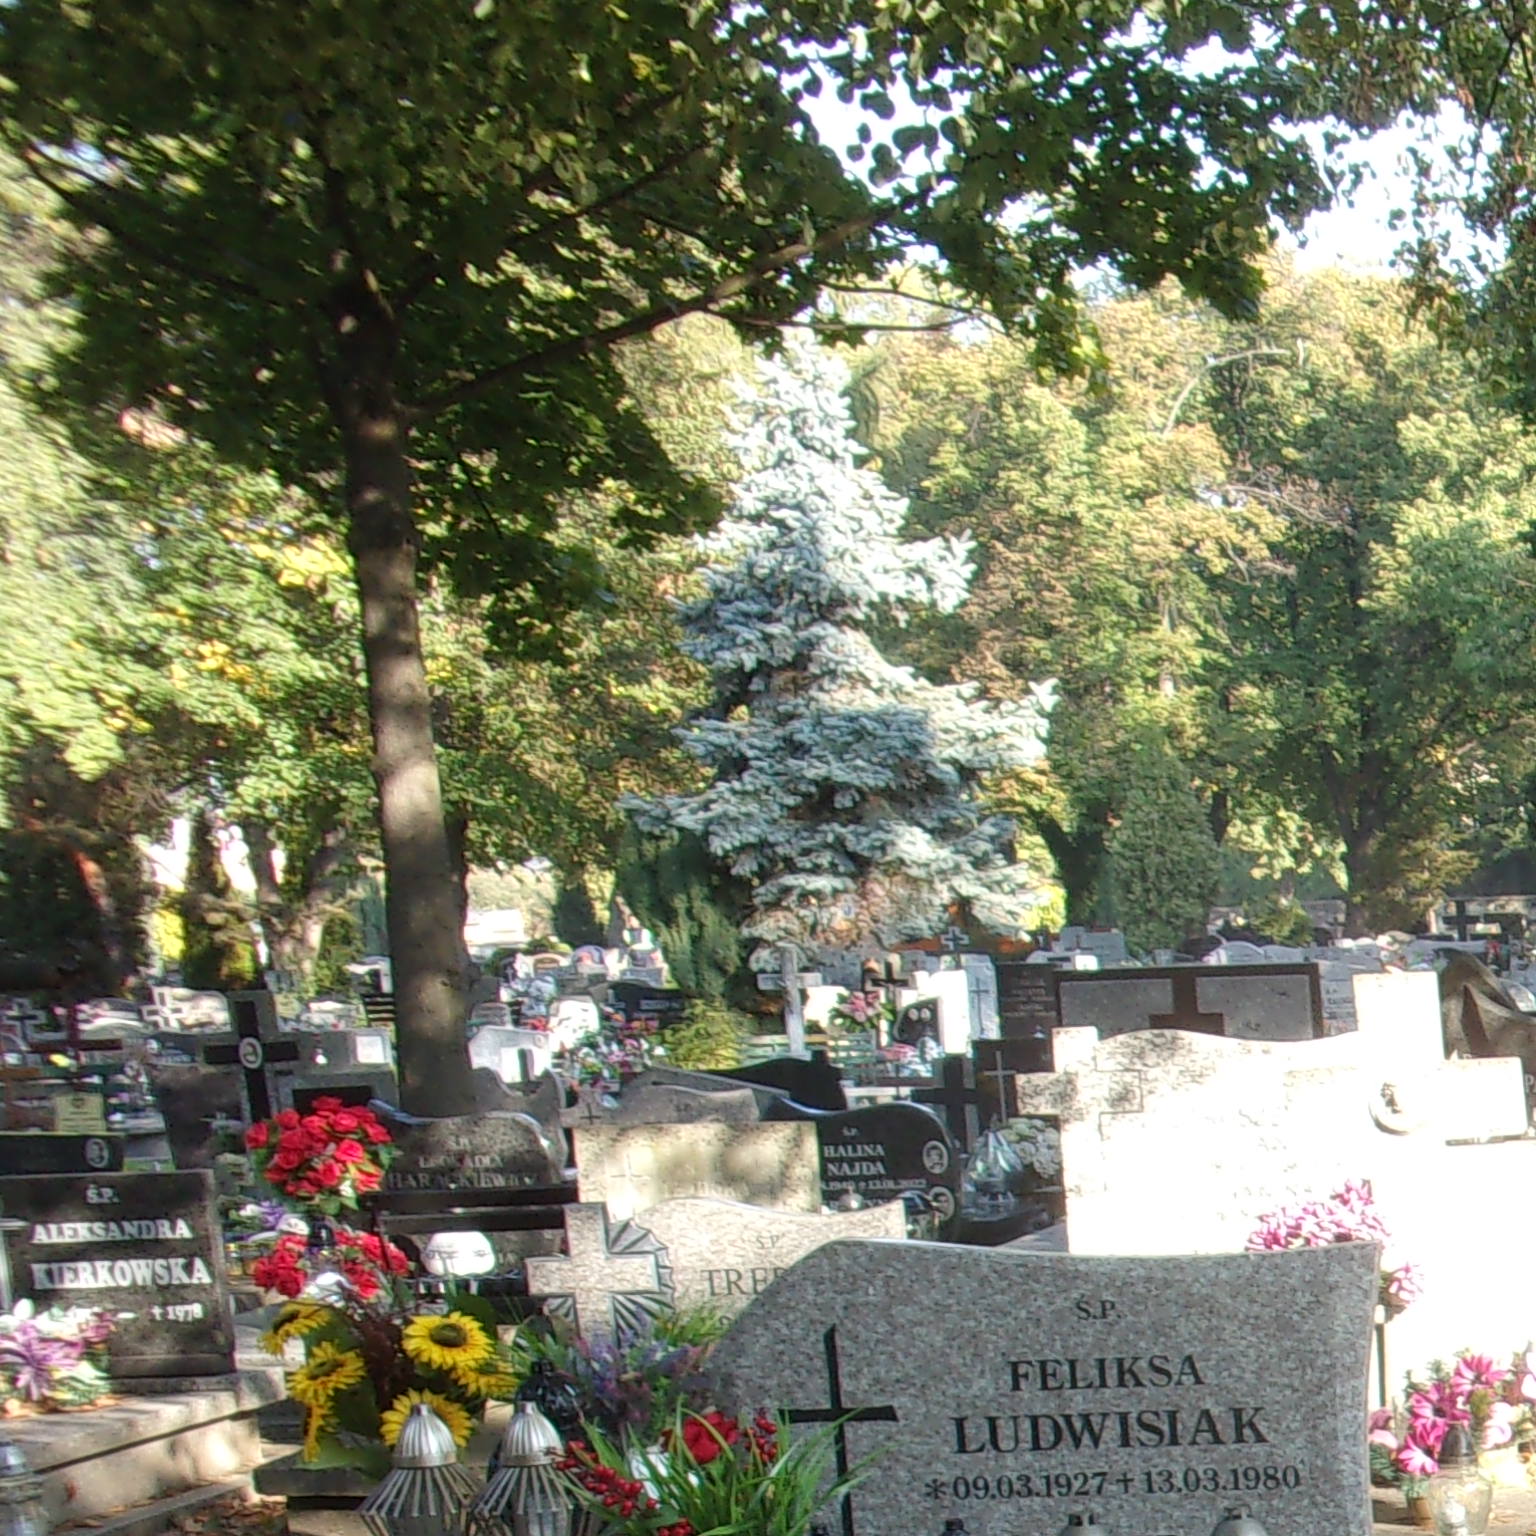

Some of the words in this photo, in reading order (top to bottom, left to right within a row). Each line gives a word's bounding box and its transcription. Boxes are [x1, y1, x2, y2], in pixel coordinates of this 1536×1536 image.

[824, 1144, 886, 1158] HALINA
[827, 1161, 887, 1177] NAJDA
[30, 1217, 194, 1244] ALEKSANDRA
[30, 1256, 213, 1290] KIERKOWSKA
[1007, 1354, 1206, 1393] FELIKSA
[949, 1405, 1270, 1455] LUDWISIAK
[1142, 1464, 1301, 1495] 13.03.1980
